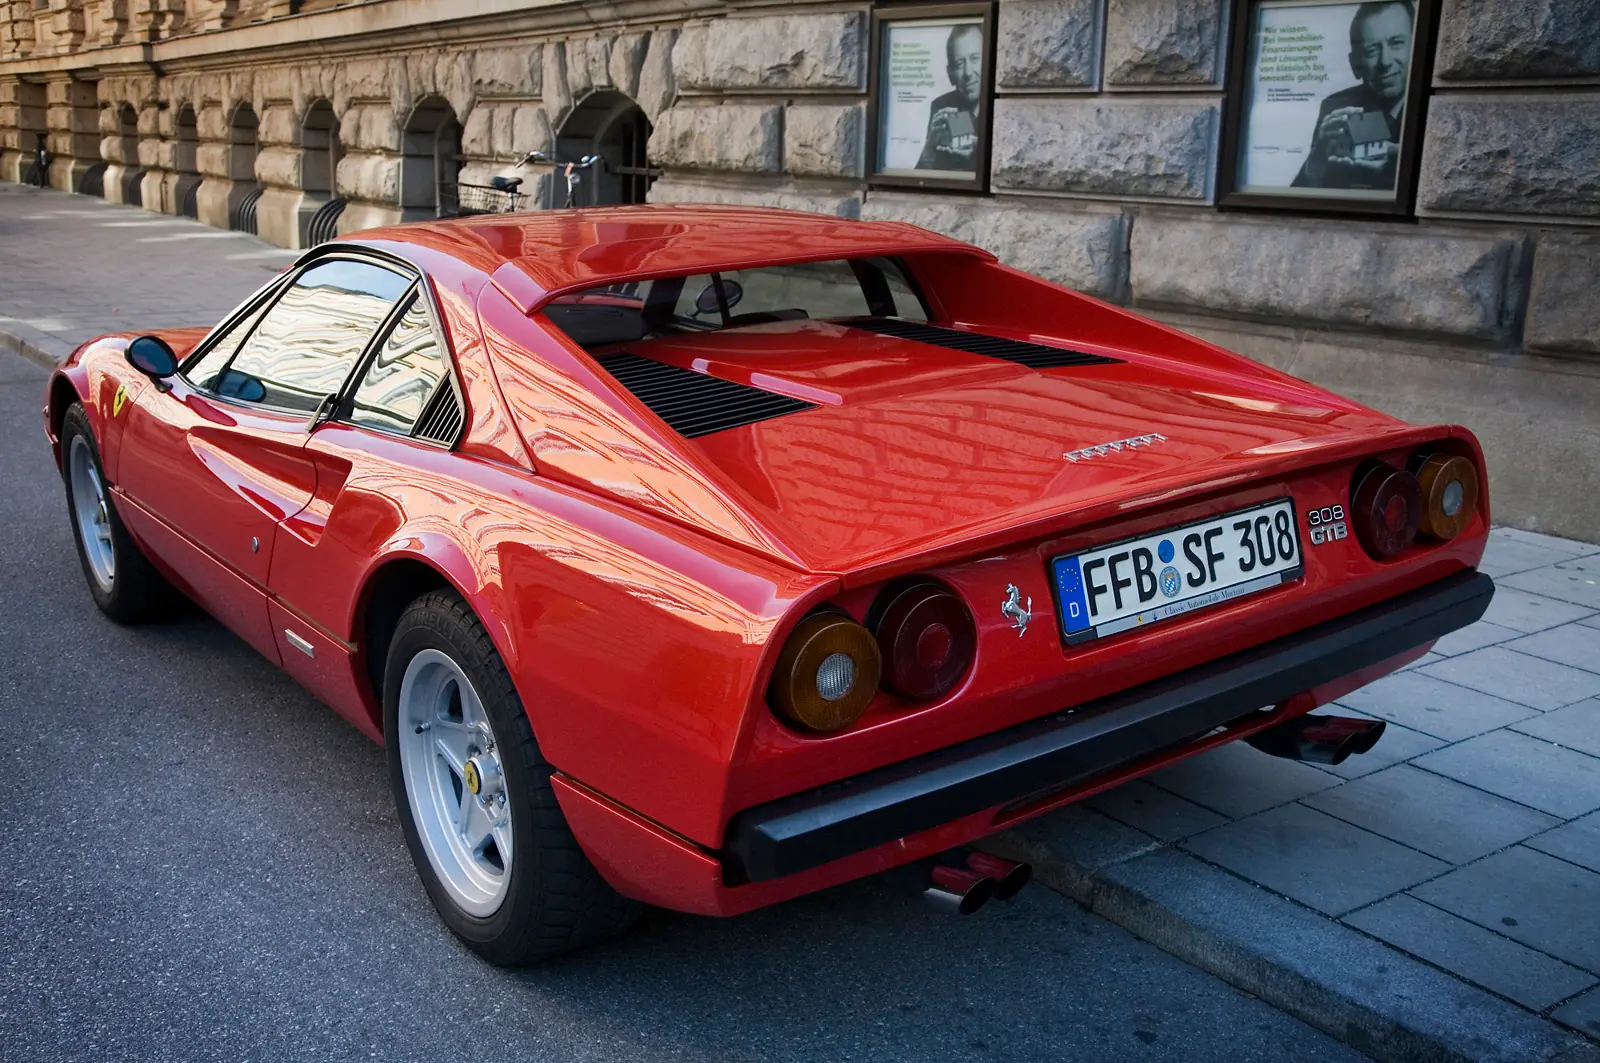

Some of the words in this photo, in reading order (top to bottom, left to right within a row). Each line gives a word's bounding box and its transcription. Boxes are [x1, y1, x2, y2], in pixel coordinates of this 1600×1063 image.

[1308, 504, 1345, 526] 308
[1309, 521, 1348, 546] GTB
[1083, 547, 1158, 617] FFB
[1182, 527, 1225, 588] SF
[1233, 510, 1294, 572] 308
[1069, 601, 1080, 618] D
